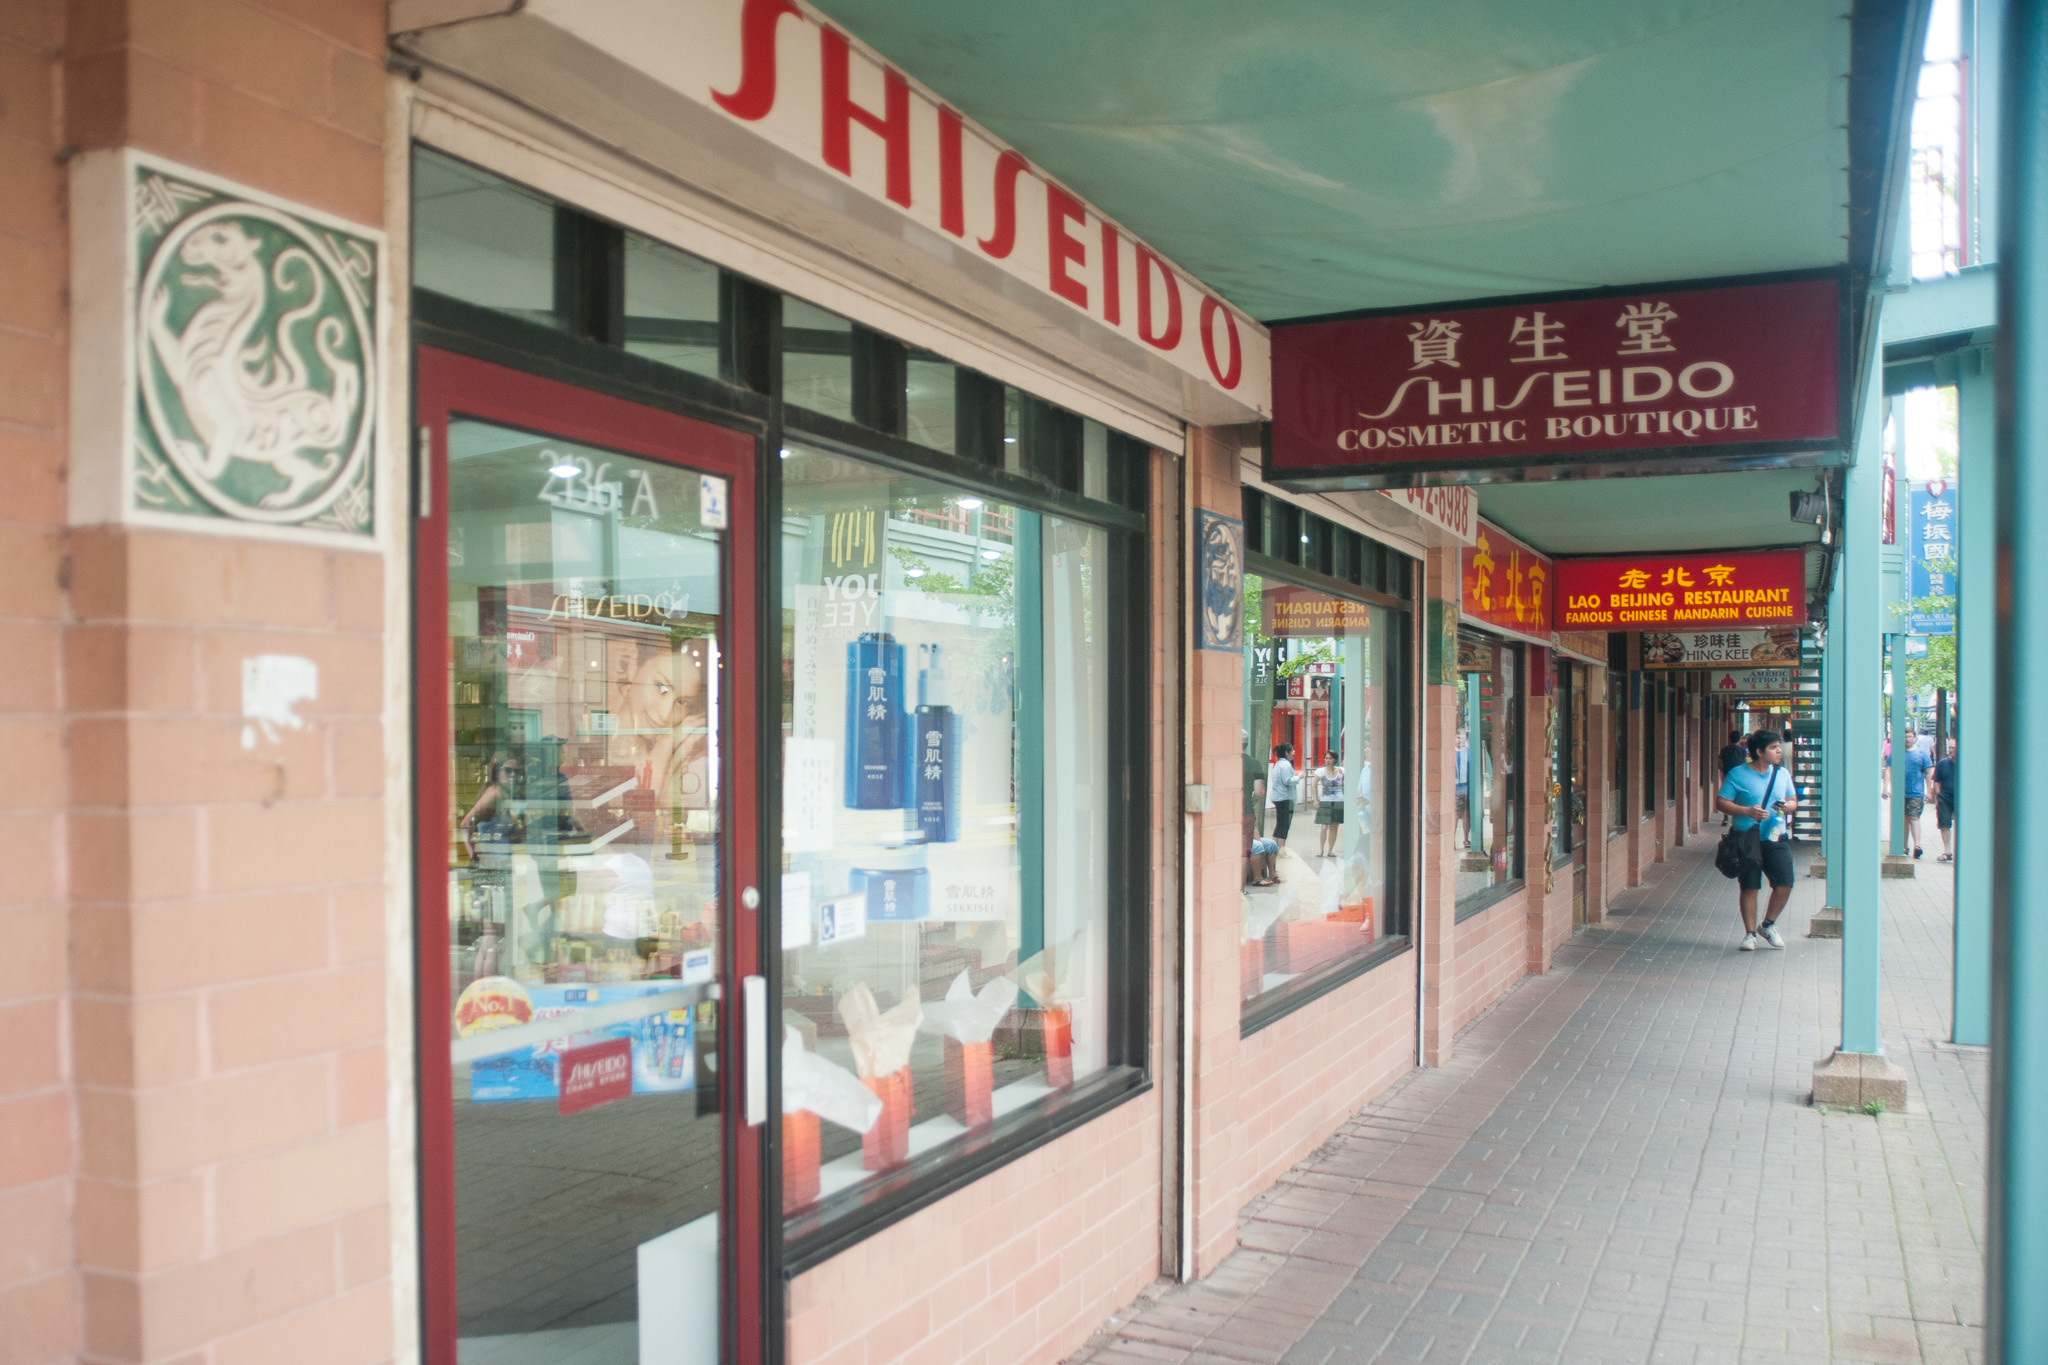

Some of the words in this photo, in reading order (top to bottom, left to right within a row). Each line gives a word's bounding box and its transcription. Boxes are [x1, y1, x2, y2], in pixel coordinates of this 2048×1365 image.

[710, 0, 1242, 390] SHISEIDO
[1407, 301, 1678, 371] 資生堂
[1357, 360, 1735, 420] SHISEIDO
[1336, 419, 1527, 451] COSMETIC
[1545, 405, 1758, 440] BOUTIQUE
[630, 469, 660, 520] A
[1568, 595, 1601, 609] LAO
[1610, 592, 1674, 607] BEIJING
[1684, 588, 1790, 605] RESTAURANT
[1619, 564, 1736, 589] 老北京
[539, 593, 676, 621] SHISEIDO
[1566, 610, 1613, 623] FAMOUS
[1620, 609, 1667, 622] CHINESE
[1673, 607, 1739, 620] MANDARIN
[1745, 605, 1793, 618] CUISINE
[1686, 649, 1722, 661] HING
[1725, 648, 1750, 661] KEE
[867, 667, 888, 721] 雪肌精
[924, 730, 943, 780] 雪肌精
[566, 1053, 627, 1083] SHISEIDO
